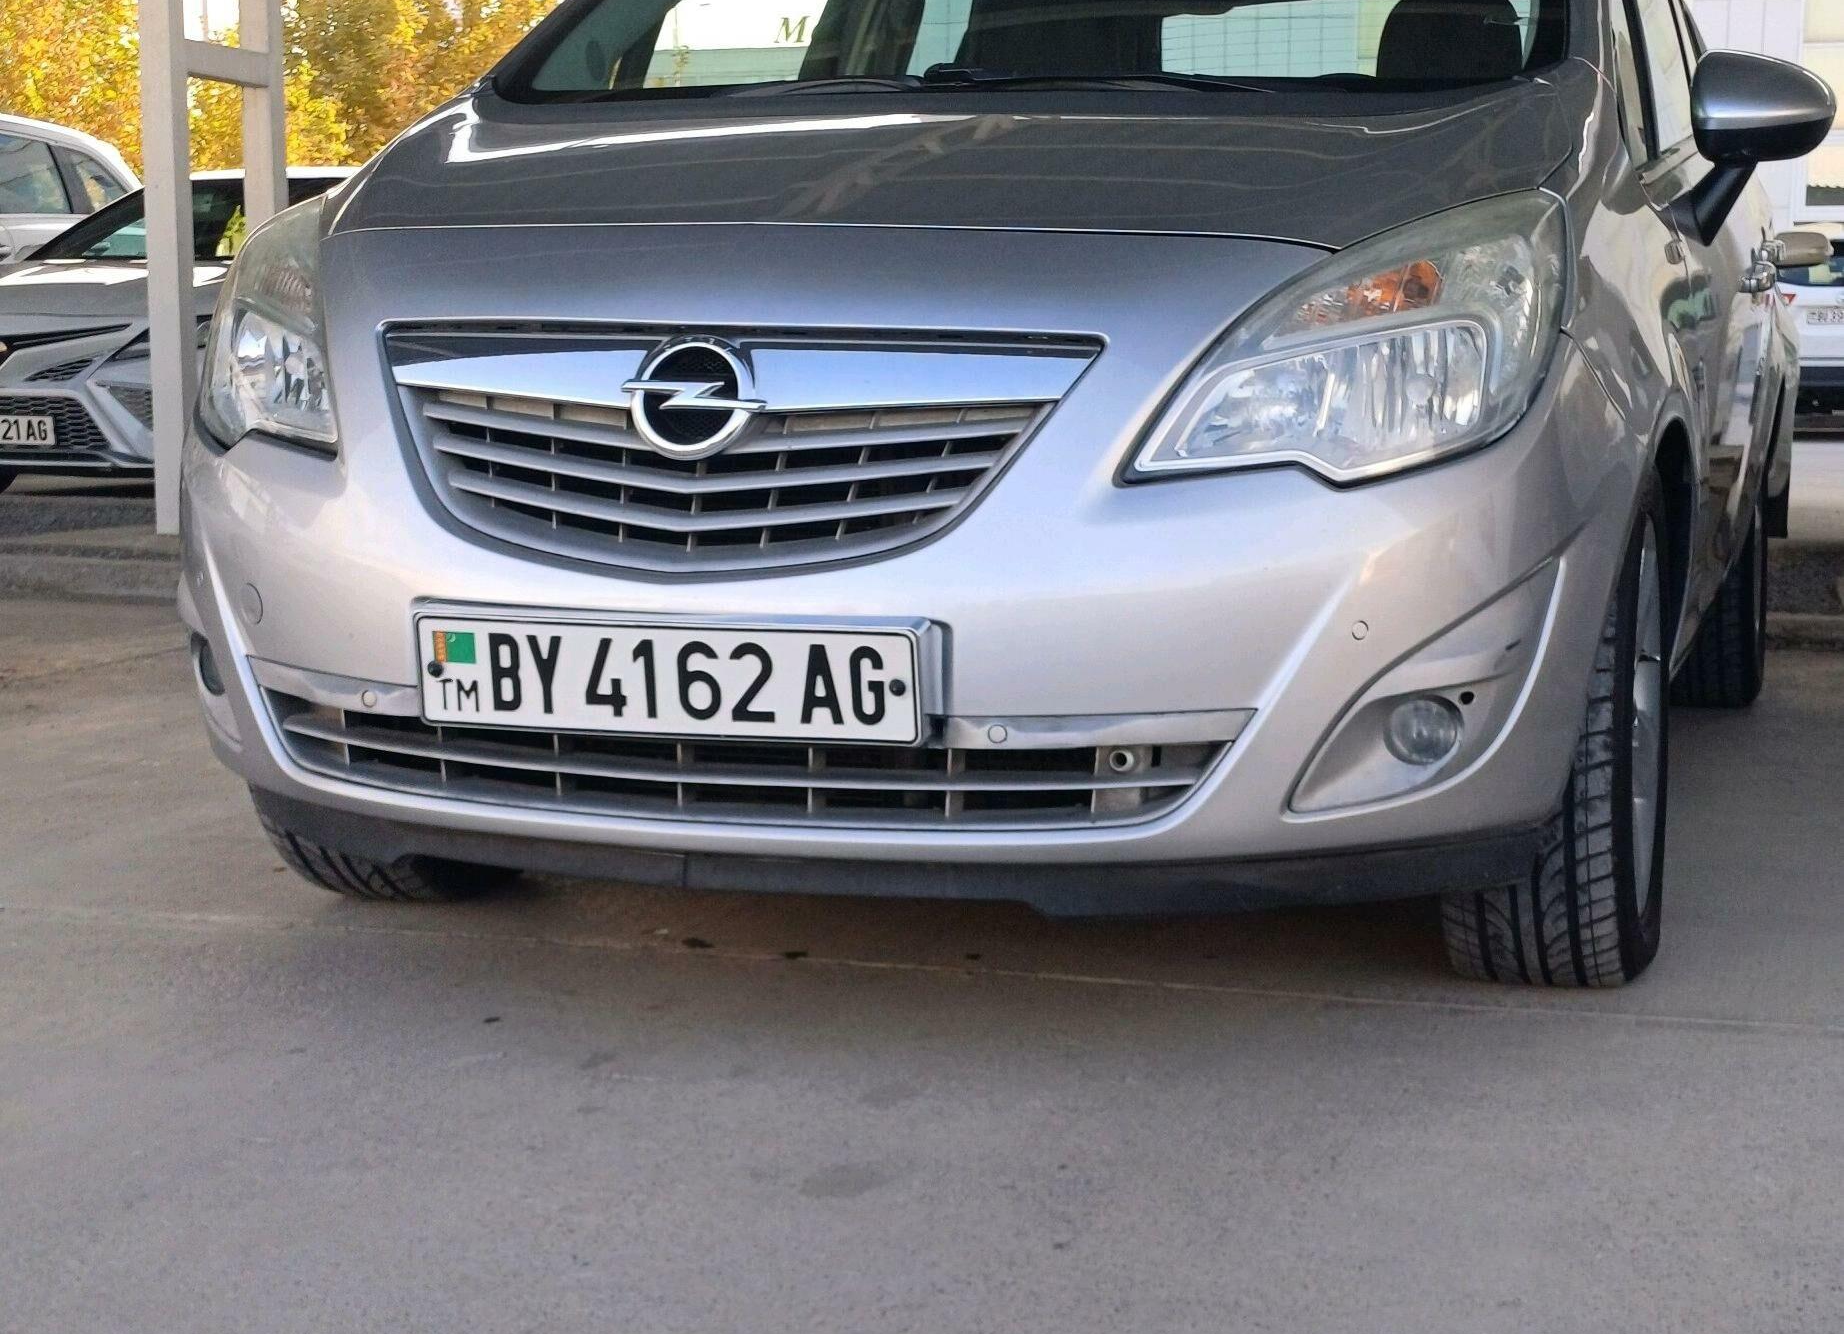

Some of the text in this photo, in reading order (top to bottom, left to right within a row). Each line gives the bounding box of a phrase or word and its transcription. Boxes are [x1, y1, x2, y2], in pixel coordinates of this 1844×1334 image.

[26, 419, 48, 441] AG
[438, 632, 886, 726] TM BY 4162 AG
